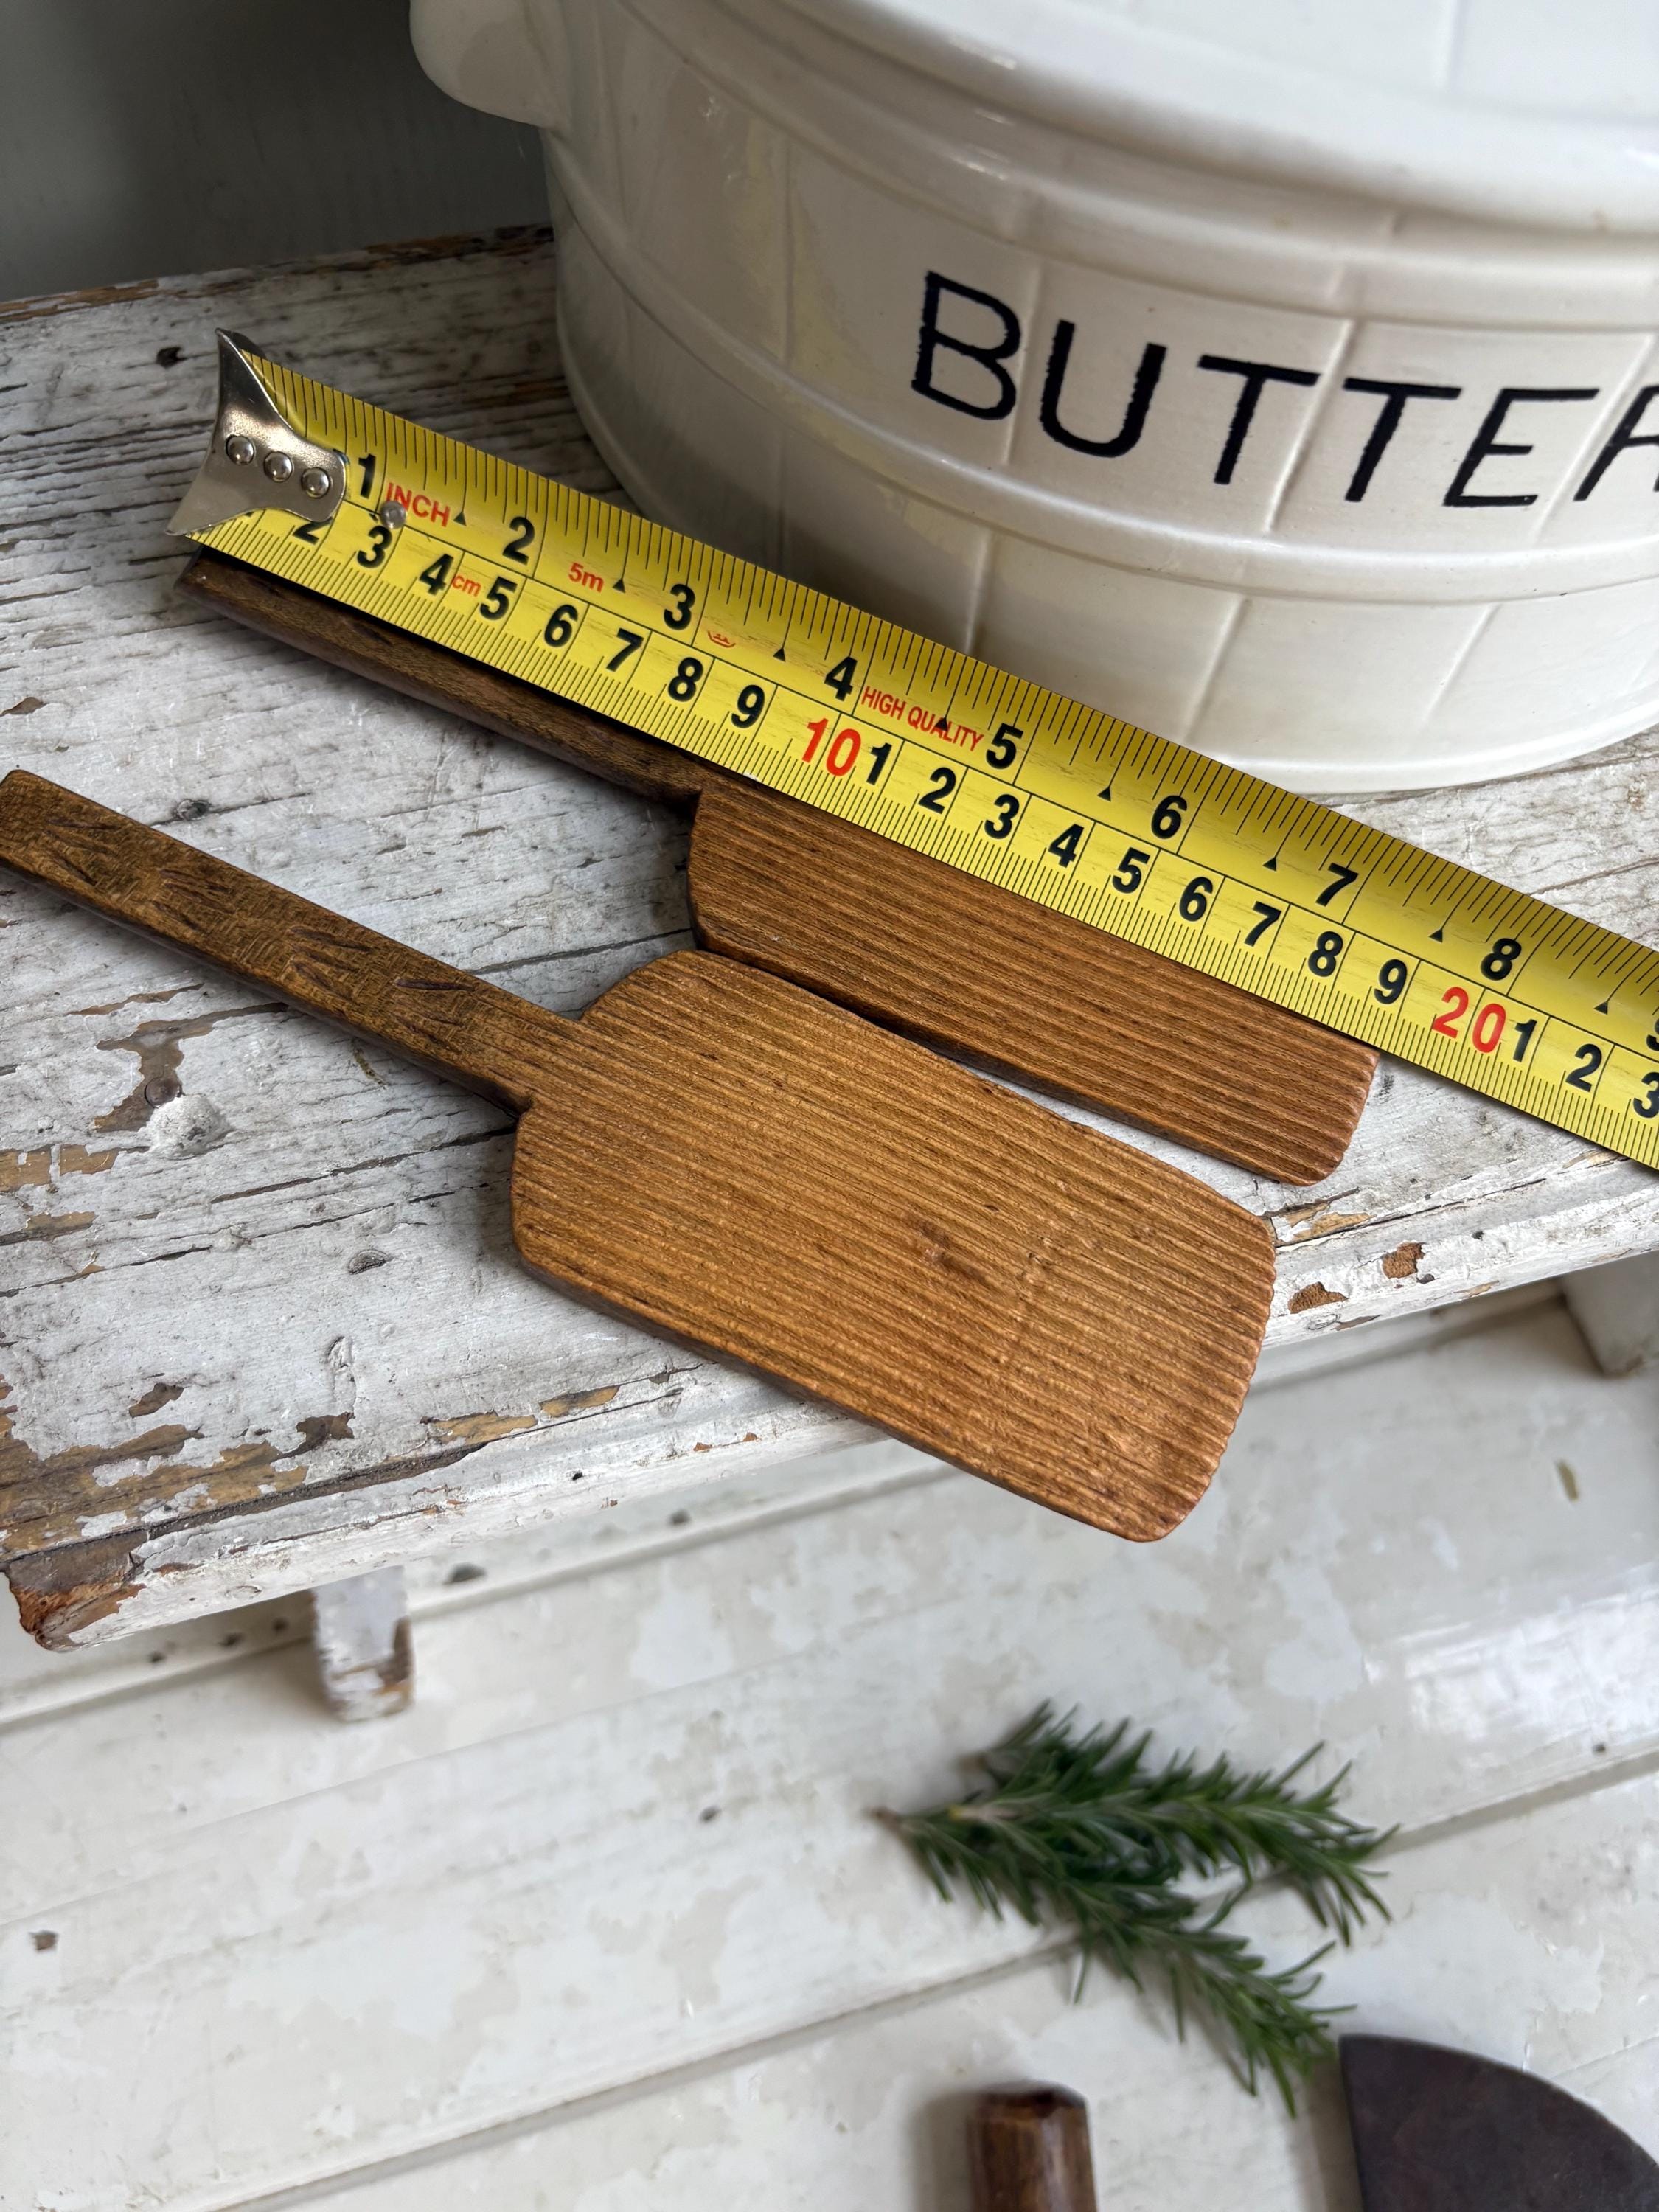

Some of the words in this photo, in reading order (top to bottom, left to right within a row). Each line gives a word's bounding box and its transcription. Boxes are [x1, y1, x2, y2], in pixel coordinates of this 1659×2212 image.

[357, 521, 392, 568] 3
[420, 554, 453, 594] 4
[451, 574, 481, 597] cm
[480, 576, 517, 619] 5
[544, 604, 578, 647] 6
[606, 627, 644, 672] 7
[668, 657, 703, 701] 8
[731, 684, 765, 728] 9
[802, 718, 861, 776] 10
[866, 742, 892, 785] 1
[918, 767, 956, 814] 2
[984, 793, 1020, 839] 3
[1048, 824, 1085, 868] 4
[1113, 847, 1150, 894] 5
[1179, 877, 1214, 922] 6
[1245, 901, 1282, 947] 7
[1308, 931, 1343, 977] 8
[1374, 959, 1408, 1004] 9
[1431, 987, 1506, 1054] 20
[1514, 1019, 1537, 1062] 1
[1565, 1043, 1602, 1092] 2
[1633, 1071, 1659, 1119] 3
[358, 453, 376, 498] 1
[386, 483, 449, 526] INCH
[502, 516, 535, 564] 2
[571, 563, 603, 591] 5m
[664, 582, 696, 630] 3
[824, 656, 858, 701] 4
[861, 686, 907, 721] HIGH
[908, 706, 983, 750] QUALITY
[986, 723, 1024, 769] 5
[1151, 794, 1188, 839] 6
[1316, 862, 1360, 907] 7
[1481, 937, 1523, 981] 8
